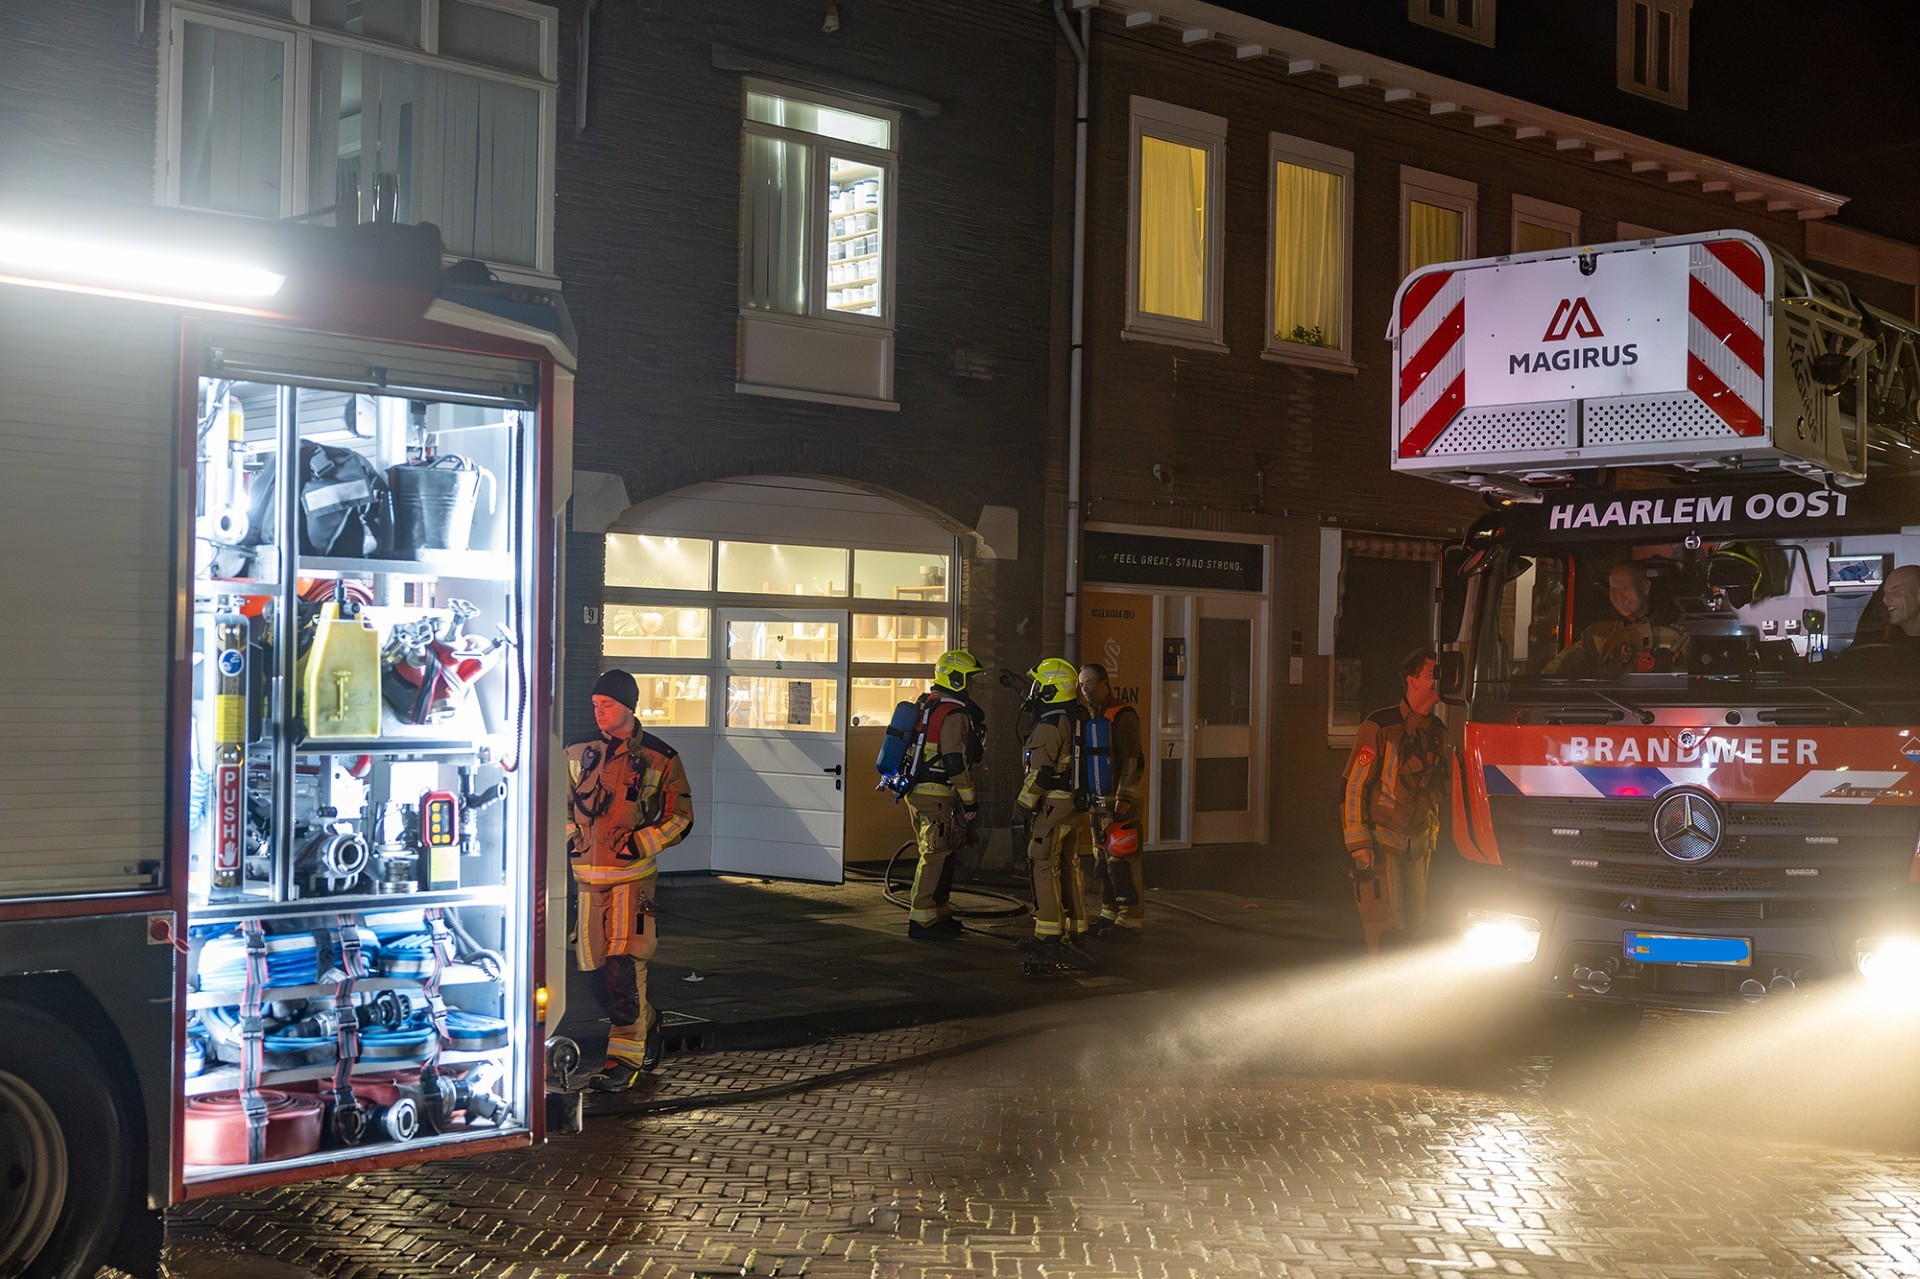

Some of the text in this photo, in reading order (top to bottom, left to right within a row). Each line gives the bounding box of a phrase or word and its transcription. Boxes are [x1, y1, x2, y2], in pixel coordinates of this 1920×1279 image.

[1509, 343, 1639, 375] MAGIRUS
[1550, 490, 1847, 530] HAARLEM OOST
[1113, 553, 1243, 571] FEEL GREAT. STAND STRONG.
[588, 608, 595, 623] 9
[1168, 742, 1175, 758] 7
[1570, 736, 1819, 765] BRANDWEER
[223, 771, 236, 839] PUSH
